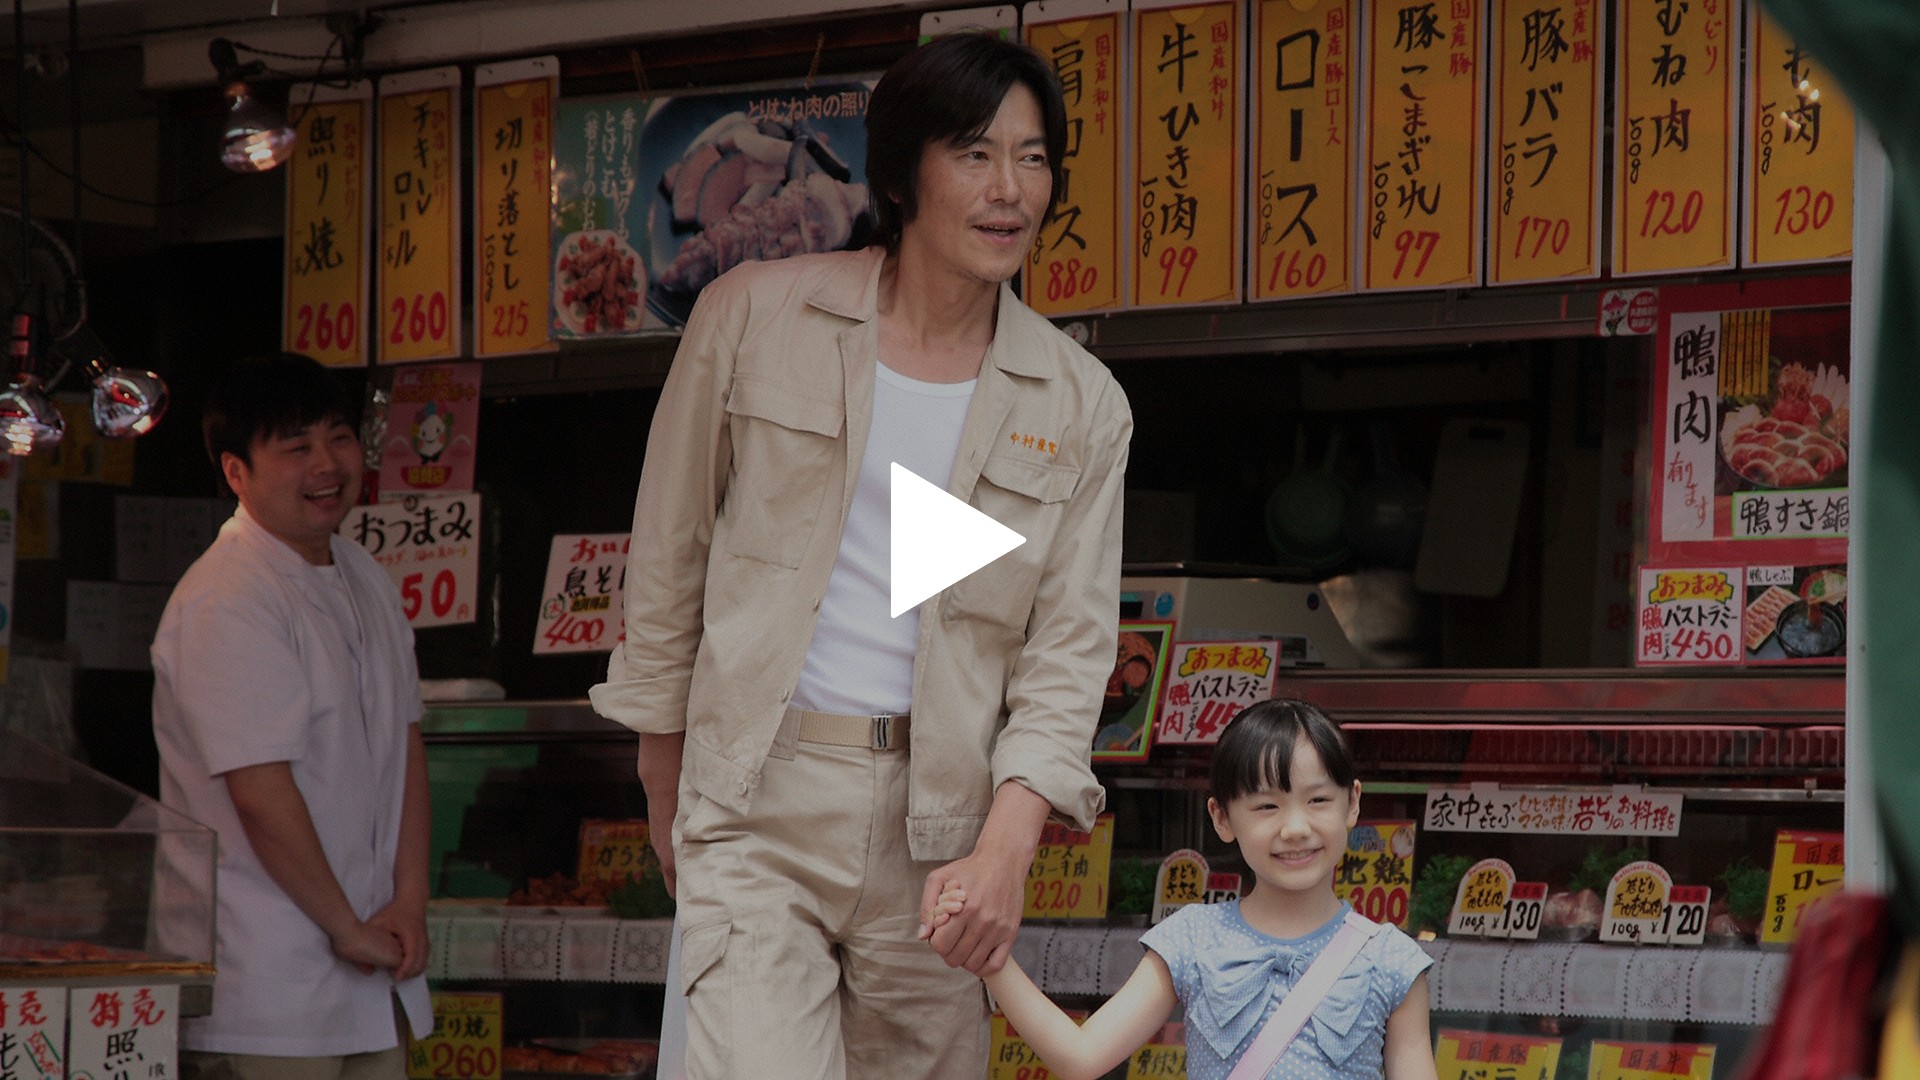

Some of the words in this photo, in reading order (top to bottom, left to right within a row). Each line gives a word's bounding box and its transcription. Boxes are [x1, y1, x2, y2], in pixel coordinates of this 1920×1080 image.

[1325, 7, 1345, 148] 国産豚ロース
[1519, 7, 1569, 188] 豚バラ
[1157, 23, 1199, 241] 牛ひき肉
[1274, 28, 1321, 247] ロース
[1628, 116, 1646, 185] 100g
[1760, 101, 1777, 176] 100g
[302, 116, 343, 276] 照り焼
[1372, 161, 1391, 240] 100g
[1502, 142, 1518, 216] 100g
[495, 117, 524, 291] 切り落とし
[1639, 189, 1705, 239] 120
[1773, 184, 1835, 236] 130
[1392, 229, 1441, 280] 97
[1514, 215, 1571, 260] 170
[1046, 257, 1097, 302] 880
[1158, 245, 1198, 298] 99
[1268, 250, 1327, 291] 160
[295, 302, 355, 351] 260
[390, 291, 447, 345] 260
[493, 301, 530, 338] 215
[1673, 325, 1716, 444] 鴨肉
[353, 501, 472, 555] おつまみ
[1740, 495, 1849, 535] 鴨すき鍋
[564, 565, 626, 598] 鳥そ
[1659, 574, 1727, 598] おつまみ
[544, 612, 604, 648] 400
[1664, 603, 1738, 630] パストラミー
[1191, 645, 1264, 671] おつまみ
[1671, 628, 1734, 660] 450
[1190, 674, 1269, 699] パストラミー
[1335, 852, 1409, 886] 地鶏
[1031, 879, 1082, 911] 220
[1350, 886, 1408, 926] 300
[1611, 921, 1641, 939] 100g
[0, 990, 48, 1029] 売
[104, 1028, 144, 1080] 照
[431, 1041, 497, 1079] 260
